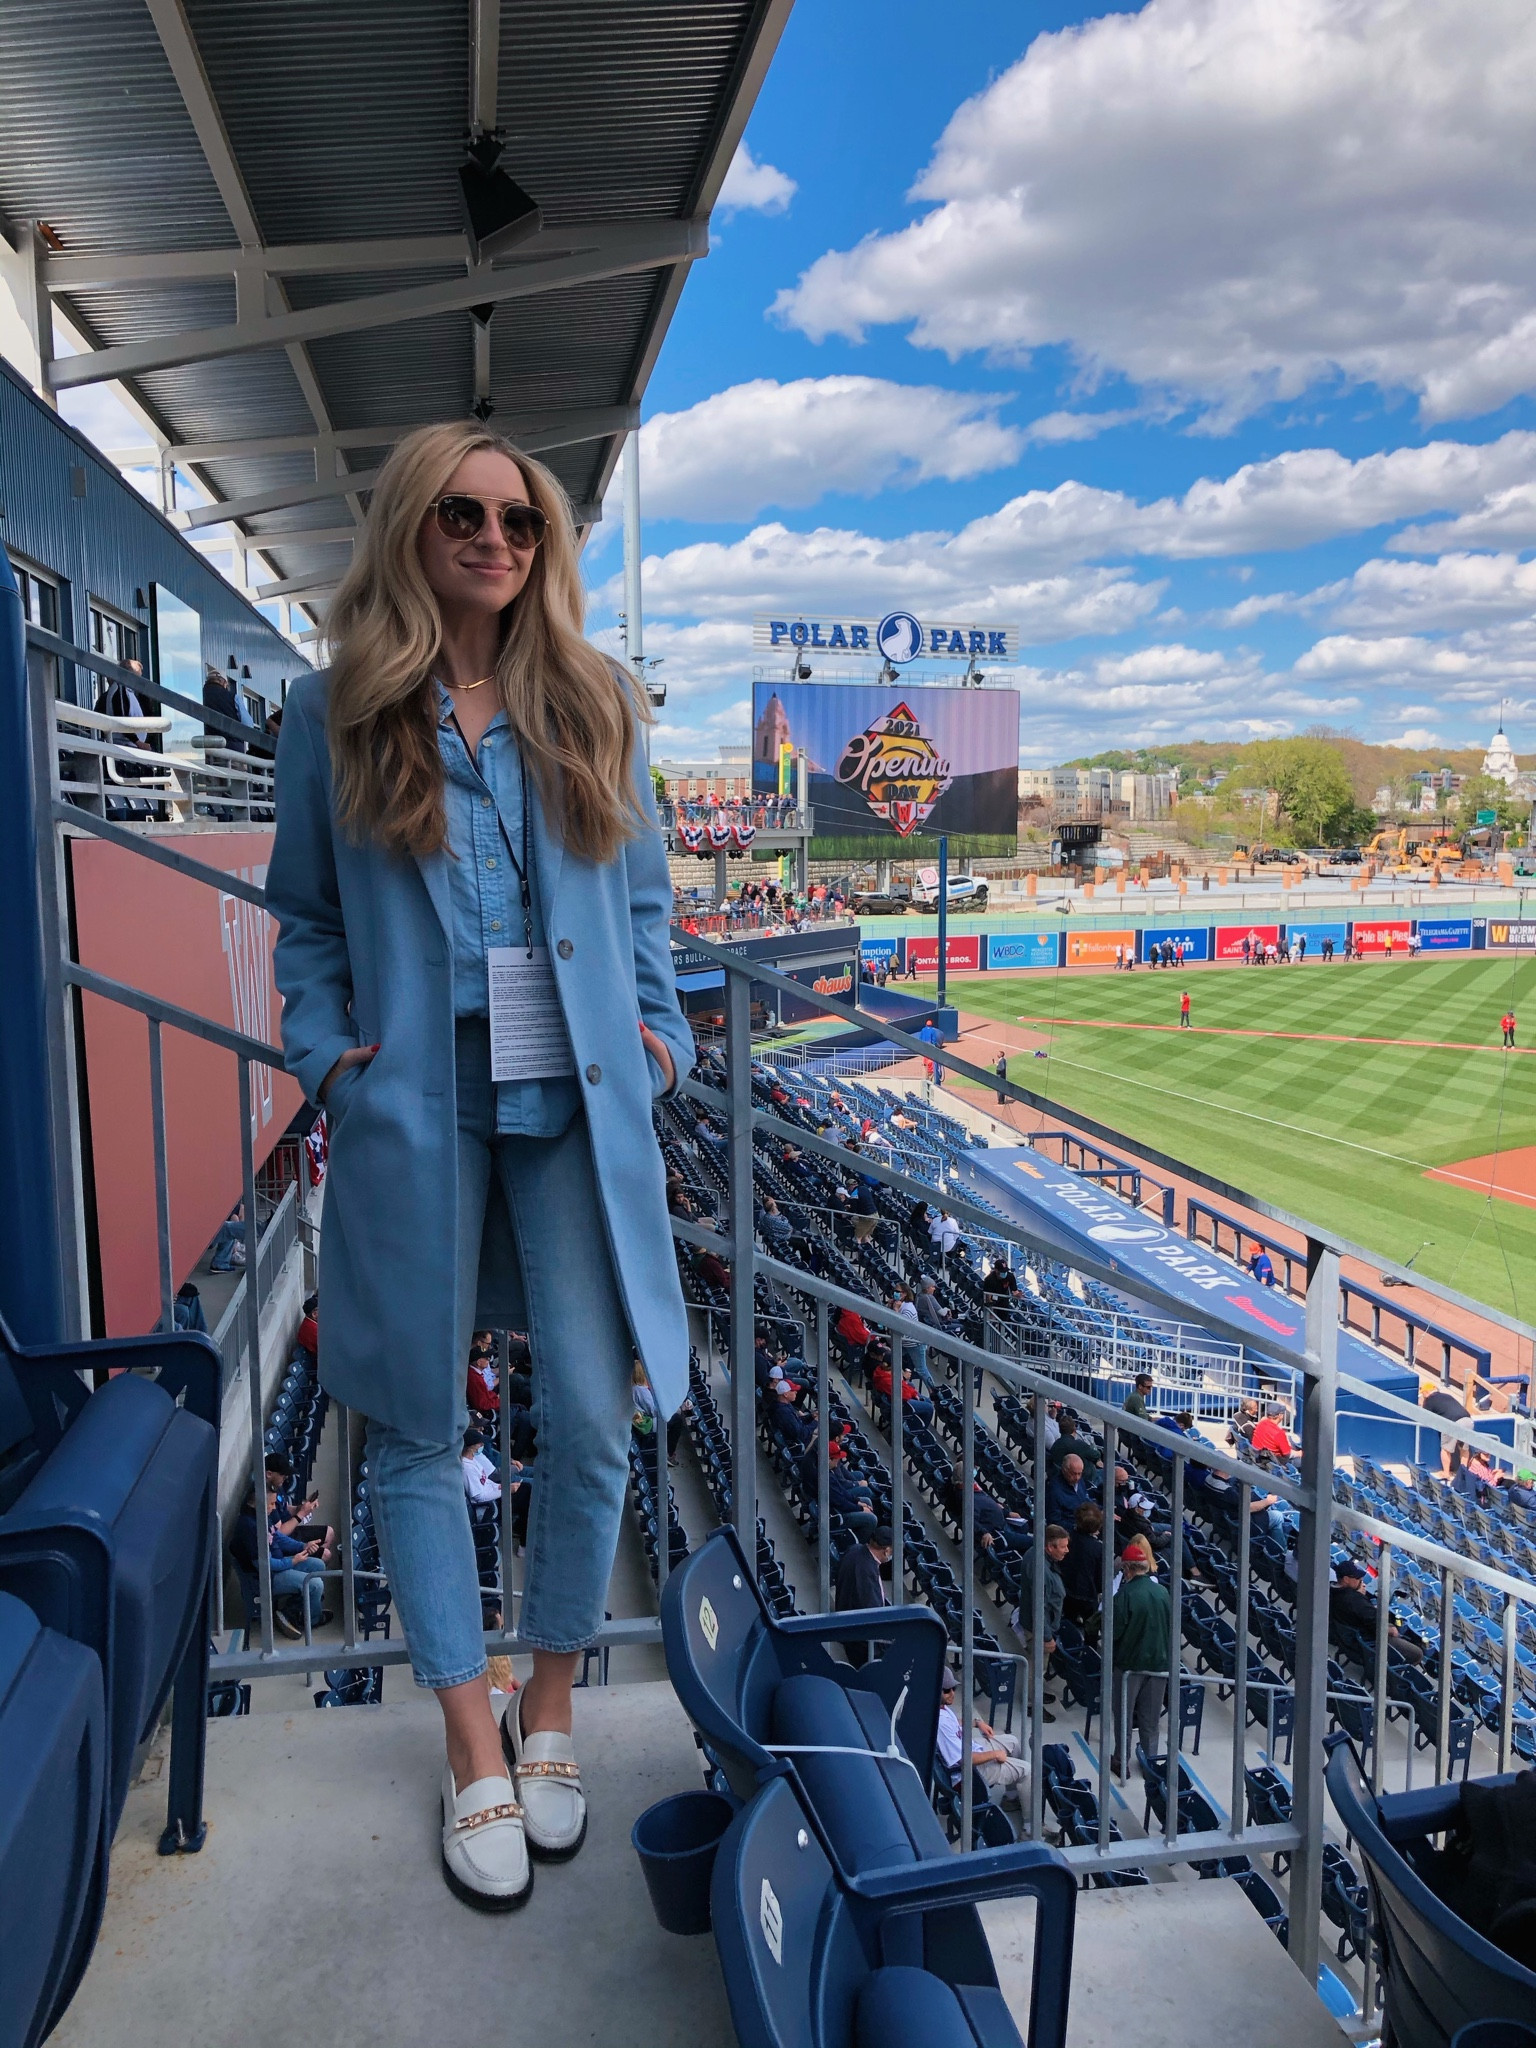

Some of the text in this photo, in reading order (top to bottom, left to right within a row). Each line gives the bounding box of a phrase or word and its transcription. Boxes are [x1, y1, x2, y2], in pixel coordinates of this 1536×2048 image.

[770, 621, 1007, 653] POLAR PARK
[886, 719, 920, 737] 2021
[835, 735, 953, 795] Opening
[887, 783, 921, 799] DAY
[1392, 930, 1408, 942] Pies
[861, 947, 892, 957] mption
[994, 945, 1025, 958] WBDC
[1044, 1183, 1126, 1222] POLAR
[1142, 1244, 1240, 1290] PARK
